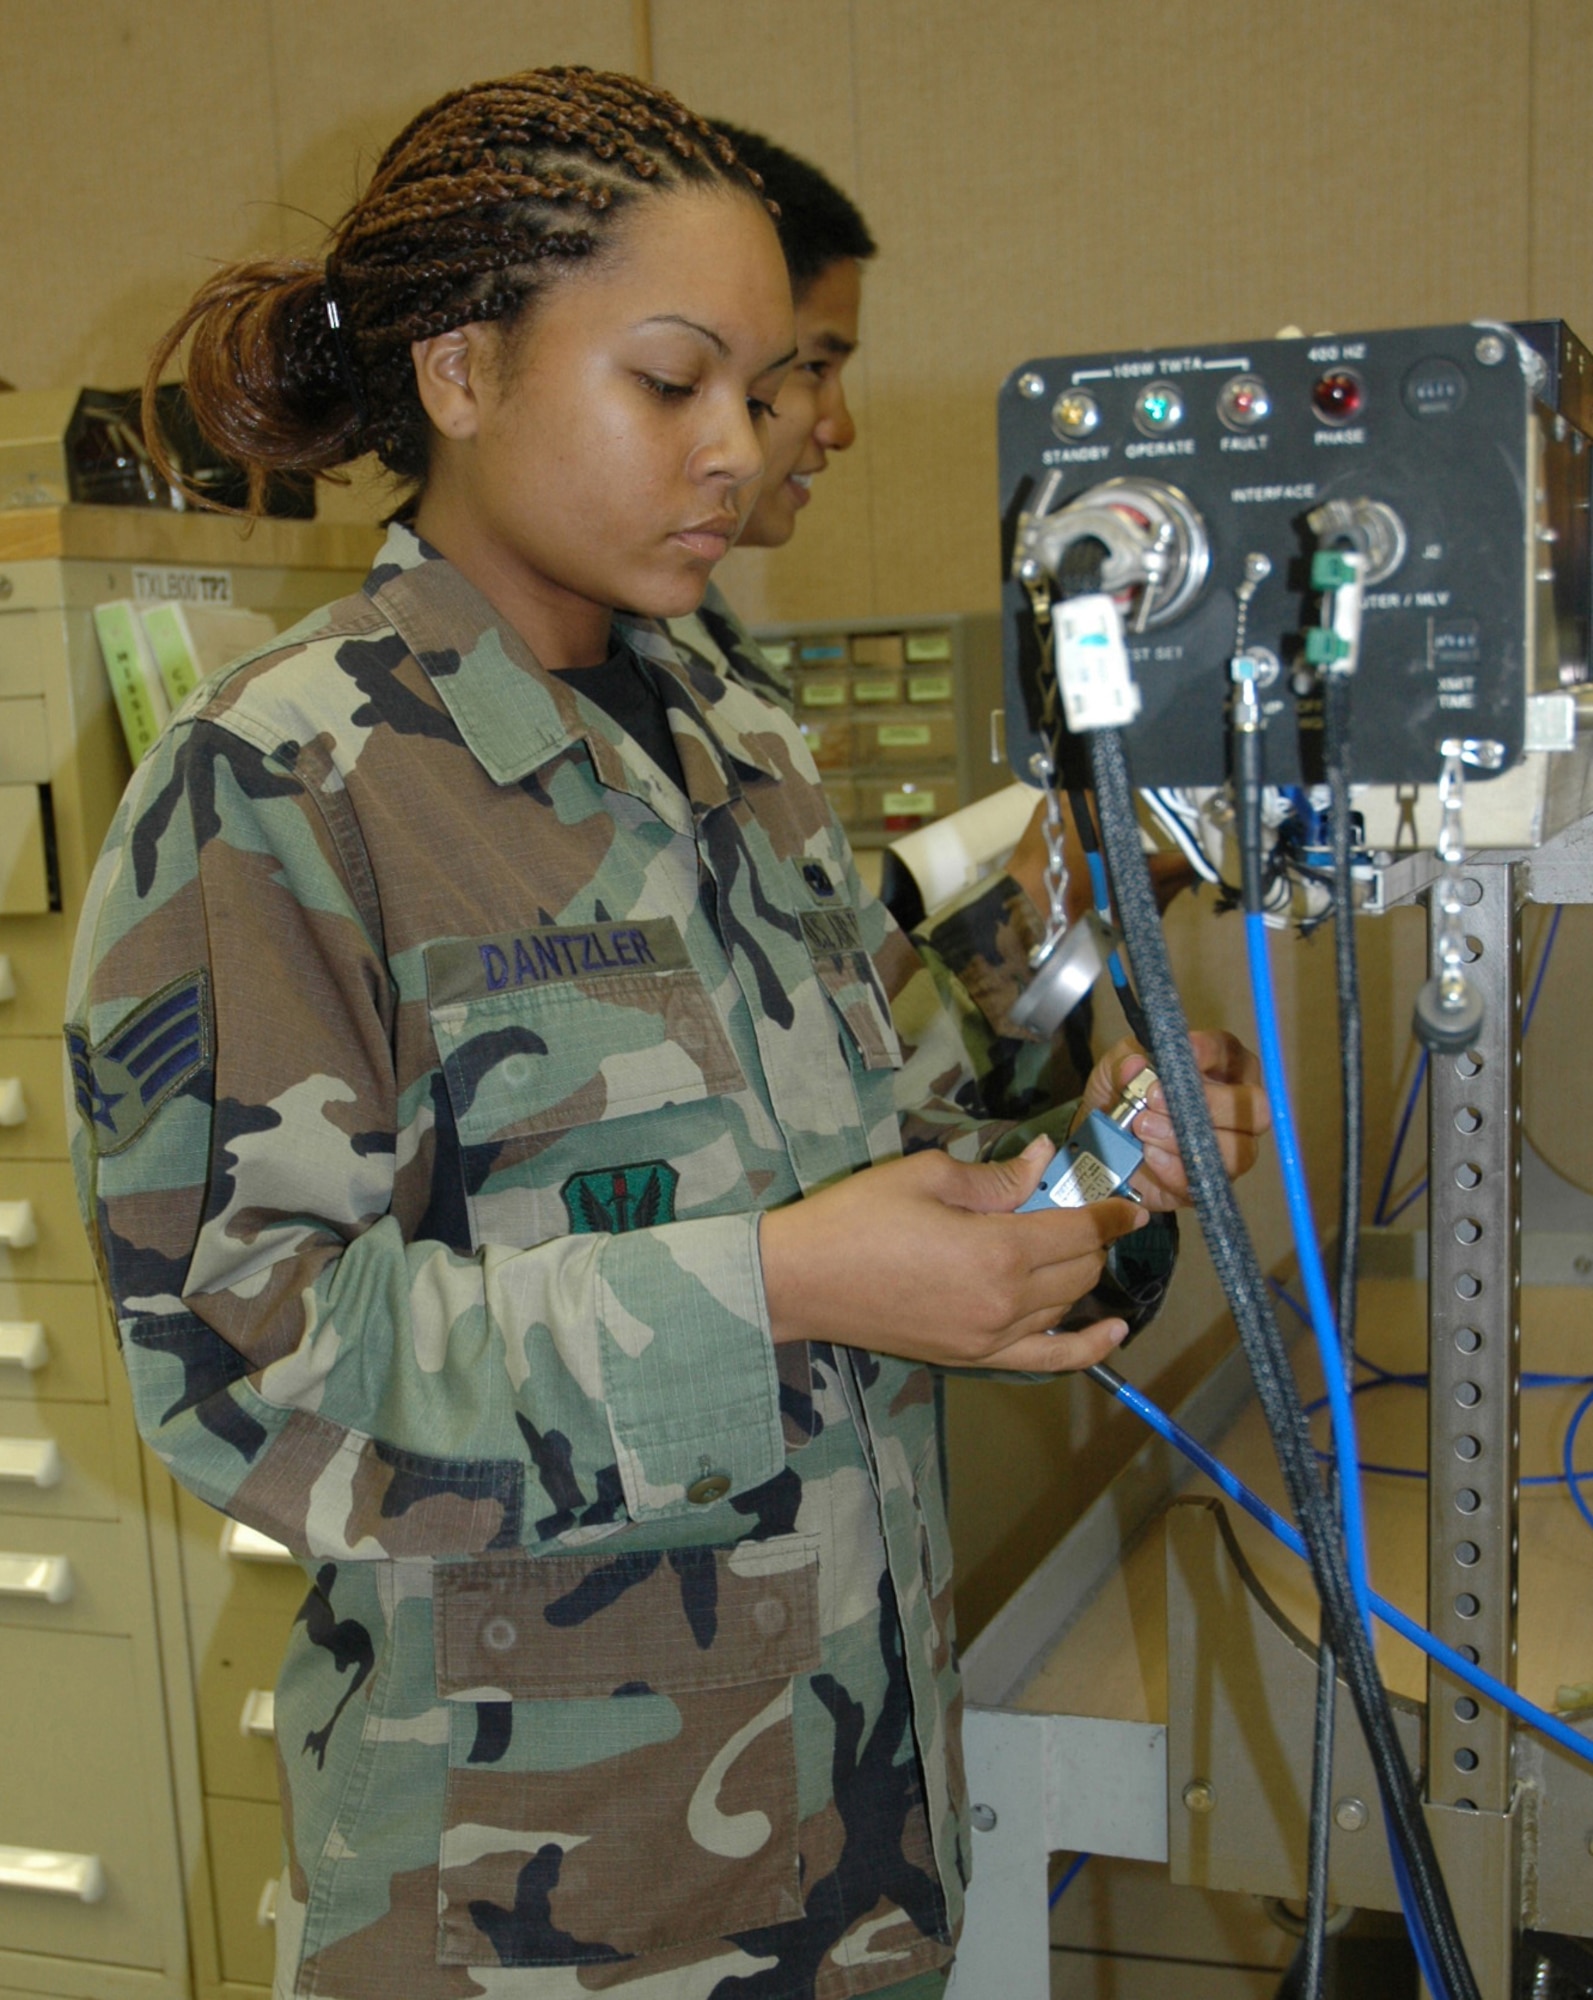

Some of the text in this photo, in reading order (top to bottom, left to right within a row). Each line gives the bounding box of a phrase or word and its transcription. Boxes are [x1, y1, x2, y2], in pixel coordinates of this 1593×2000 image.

[1308, 343, 1366, 361] 400 HZ
[1220, 434, 1268, 451] FAULT
[1314, 428, 1365, 445] PHASE
[1042, 446, 1110, 465] STANDBY
[1125, 440, 1195, 458] OPERATE
[1231, 484, 1316, 502] INTERFACE
[116, 651, 150, 746] MISSIO
[480, 928, 657, 991] DANTZLER
